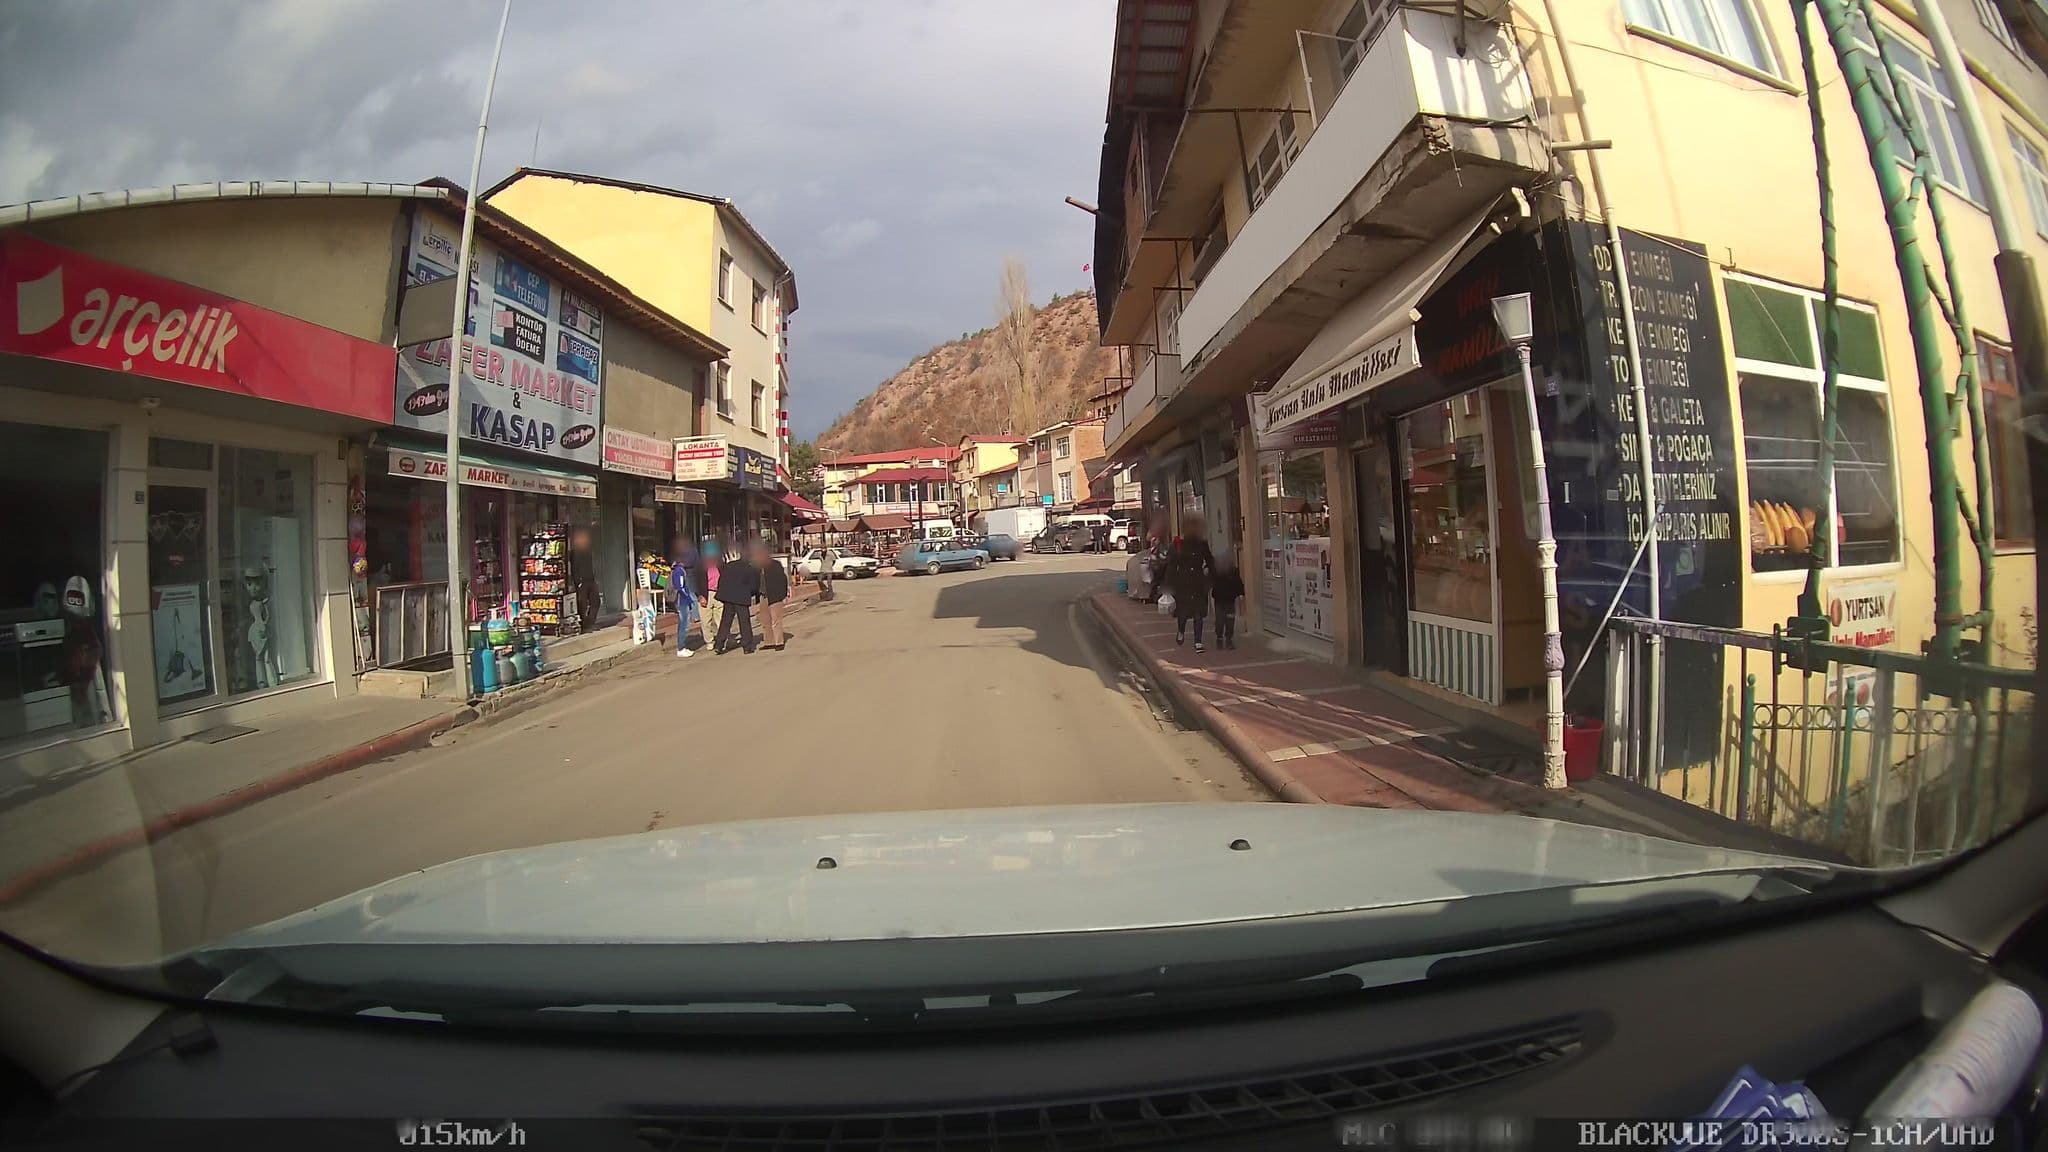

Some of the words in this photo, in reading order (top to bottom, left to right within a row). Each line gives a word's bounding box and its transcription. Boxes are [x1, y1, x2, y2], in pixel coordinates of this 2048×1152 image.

[527, 271, 541, 288] CEP
[517, 285, 548, 312] TELEFONU
[1600, 279, 1656, 314] TRZON
[70, 287, 238, 372] arçelik
[516, 313, 543, 333] KONTÖR
[516, 326, 541, 344] FATURA
[1648, 321, 1691, 352] EKMEĞİ
[515, 337, 541, 356] ÖDEME
[1646, 354, 1690, 388] EKMEĞİ
[511, 359, 596, 415] MARKET
[513, 391, 522, 409] &
[1617, 393, 1634, 422] KE
[1650, 396, 1658, 423] &
[1661, 396, 1705, 426] GALETA
[470, 403, 556, 452] KASAP
[684, 441, 720, 450] LOKANTA
[1656, 434, 1665, 462] &
[1666, 430, 1714, 466] POĞAÇA
[424, 459, 447, 476] ZAF
[467, 467, 510, 485] MARKET
[1700, 512, 1731, 540] ALINIR
[1845, 596, 1886, 622] YURTSAN
